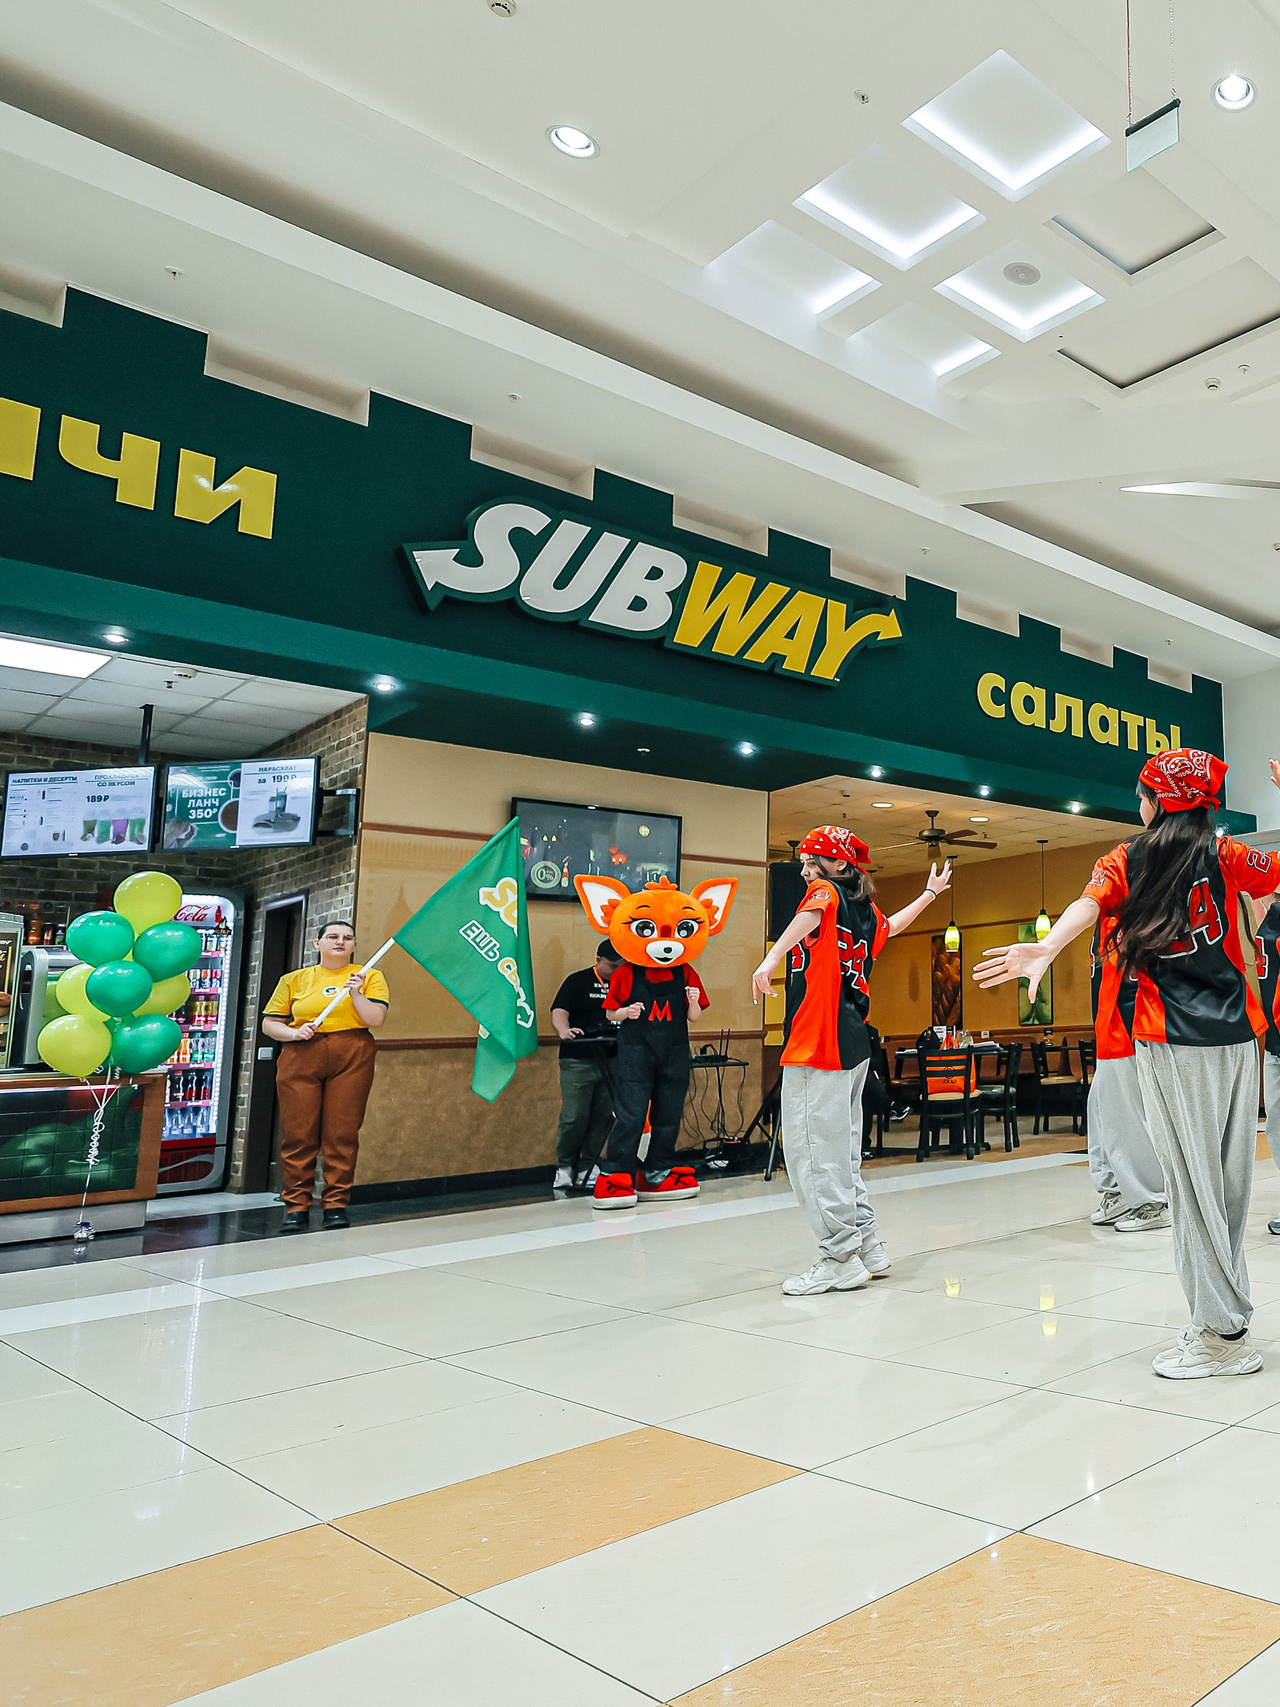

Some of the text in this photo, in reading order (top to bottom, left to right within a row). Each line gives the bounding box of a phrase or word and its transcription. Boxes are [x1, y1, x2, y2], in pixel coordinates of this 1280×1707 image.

[411, 502, 903, 681] SUBWAY
[976, 672, 1181, 756] салаты
[182, 788, 227, 798] БИЗНЕС
[187, 799, 220, 808] ЛАНЧ
